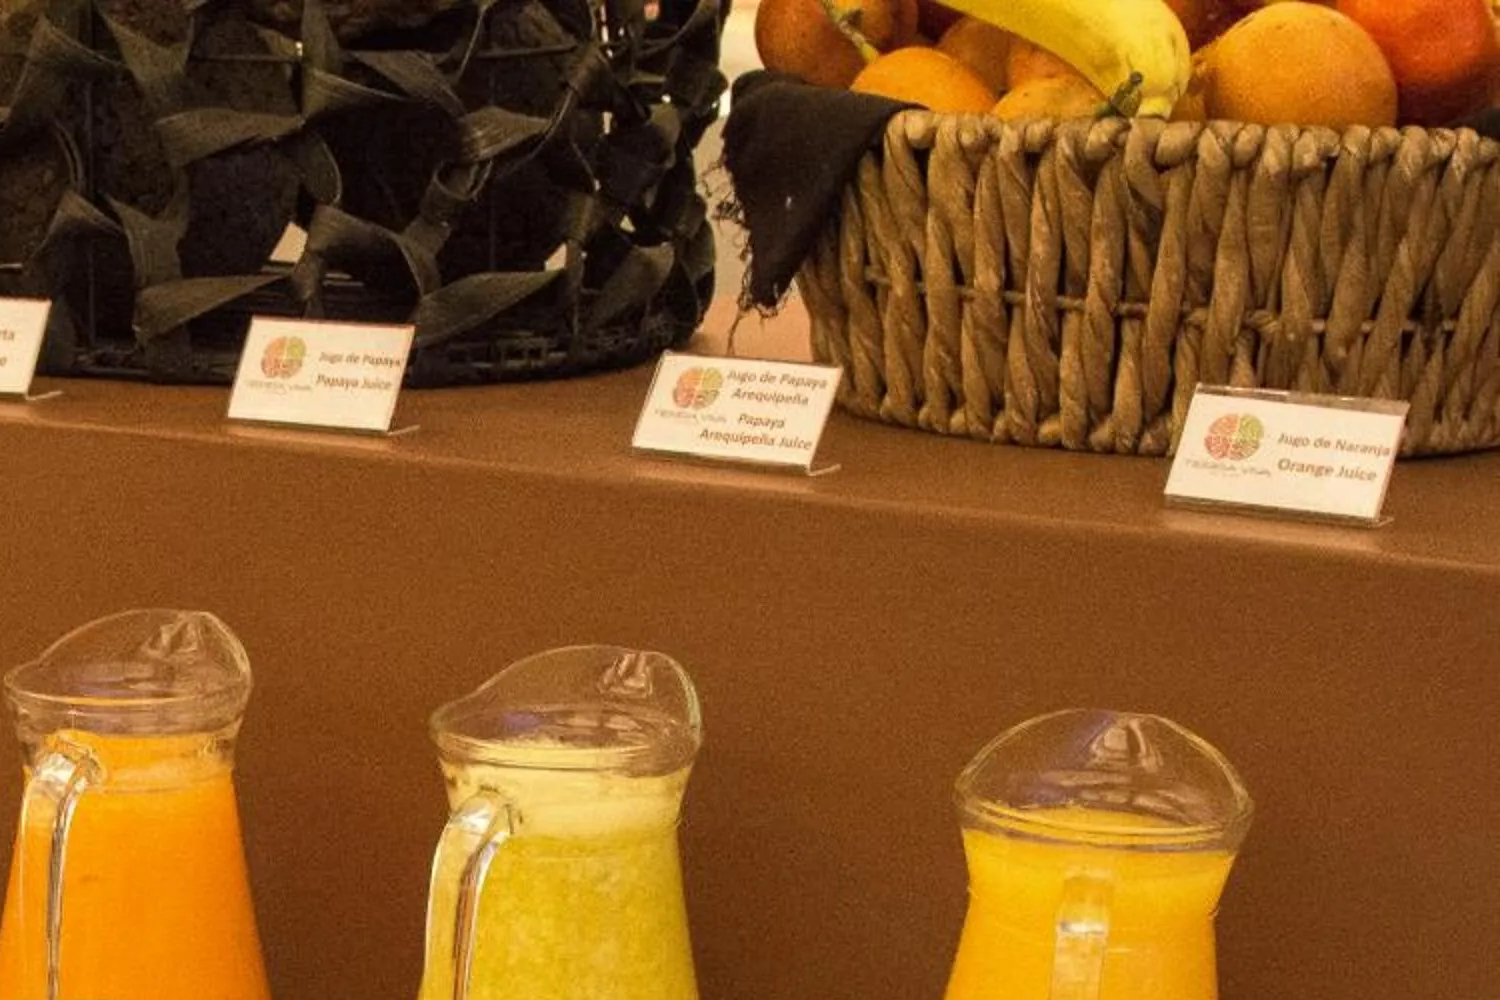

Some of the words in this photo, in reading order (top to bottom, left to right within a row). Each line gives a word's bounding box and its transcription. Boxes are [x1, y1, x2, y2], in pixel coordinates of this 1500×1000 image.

[318, 352, 344, 366] Jugo
[345, 353, 361, 364] de
[362, 354, 403, 369] Papaya
[315, 374, 359, 392] Papaya
[361, 379, 393, 391] Juice
[727, 370, 757, 384] Jugo
[760, 371, 777, 383] de
[779, 373, 828, 390] Papaya
[738, 413, 786, 430] Papaya
[779, 436, 813, 450] Juice
[1278, 432, 1311, 449] Jugo
[1313, 435, 1333, 449] de
[1335, 438, 1391, 457] Naranja
[1277, 458, 1335, 478] Orange
[1338, 465, 1378, 482] Juice
